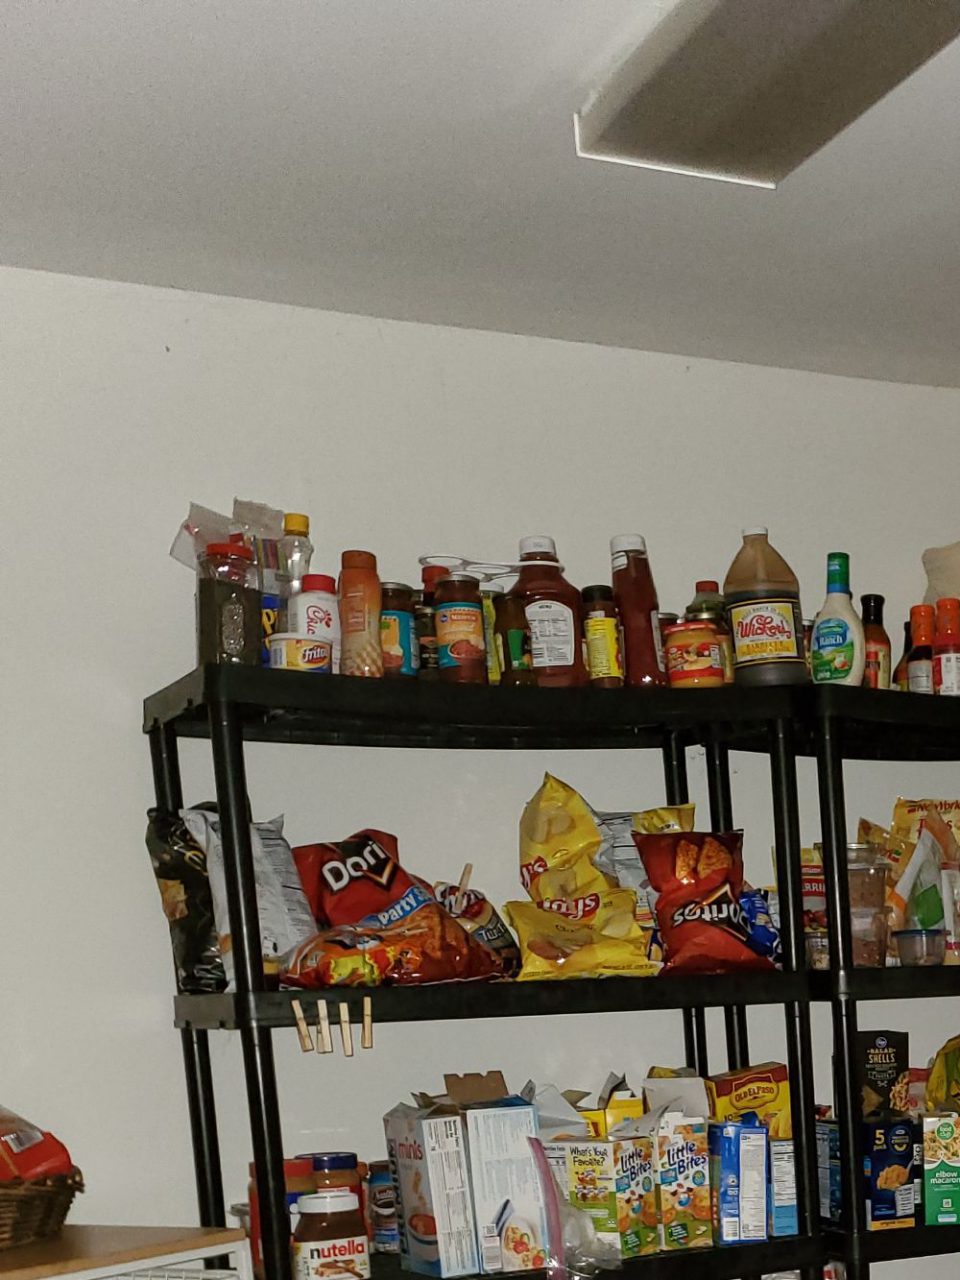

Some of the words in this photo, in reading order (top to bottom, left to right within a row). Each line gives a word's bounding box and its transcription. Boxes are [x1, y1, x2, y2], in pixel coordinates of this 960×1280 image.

[377, 893, 419, 927] Party
[868, 1054, 895, 1064] SHELLS
[734, 1091, 748, 1103] OLD
[757, 1084, 775, 1098] PASO
[874, 1129, 886, 1145] 5
[569, 1146, 592, 1158] What's
[620, 1146, 643, 1168] Little
[667, 1141, 697, 1166] Little
[629, 1159, 652, 1182] Bites
[677, 1153, 708, 1176] Bites
[935, 1170, 959, 1179] elbow
[310, 1239, 366, 1260] nutella
